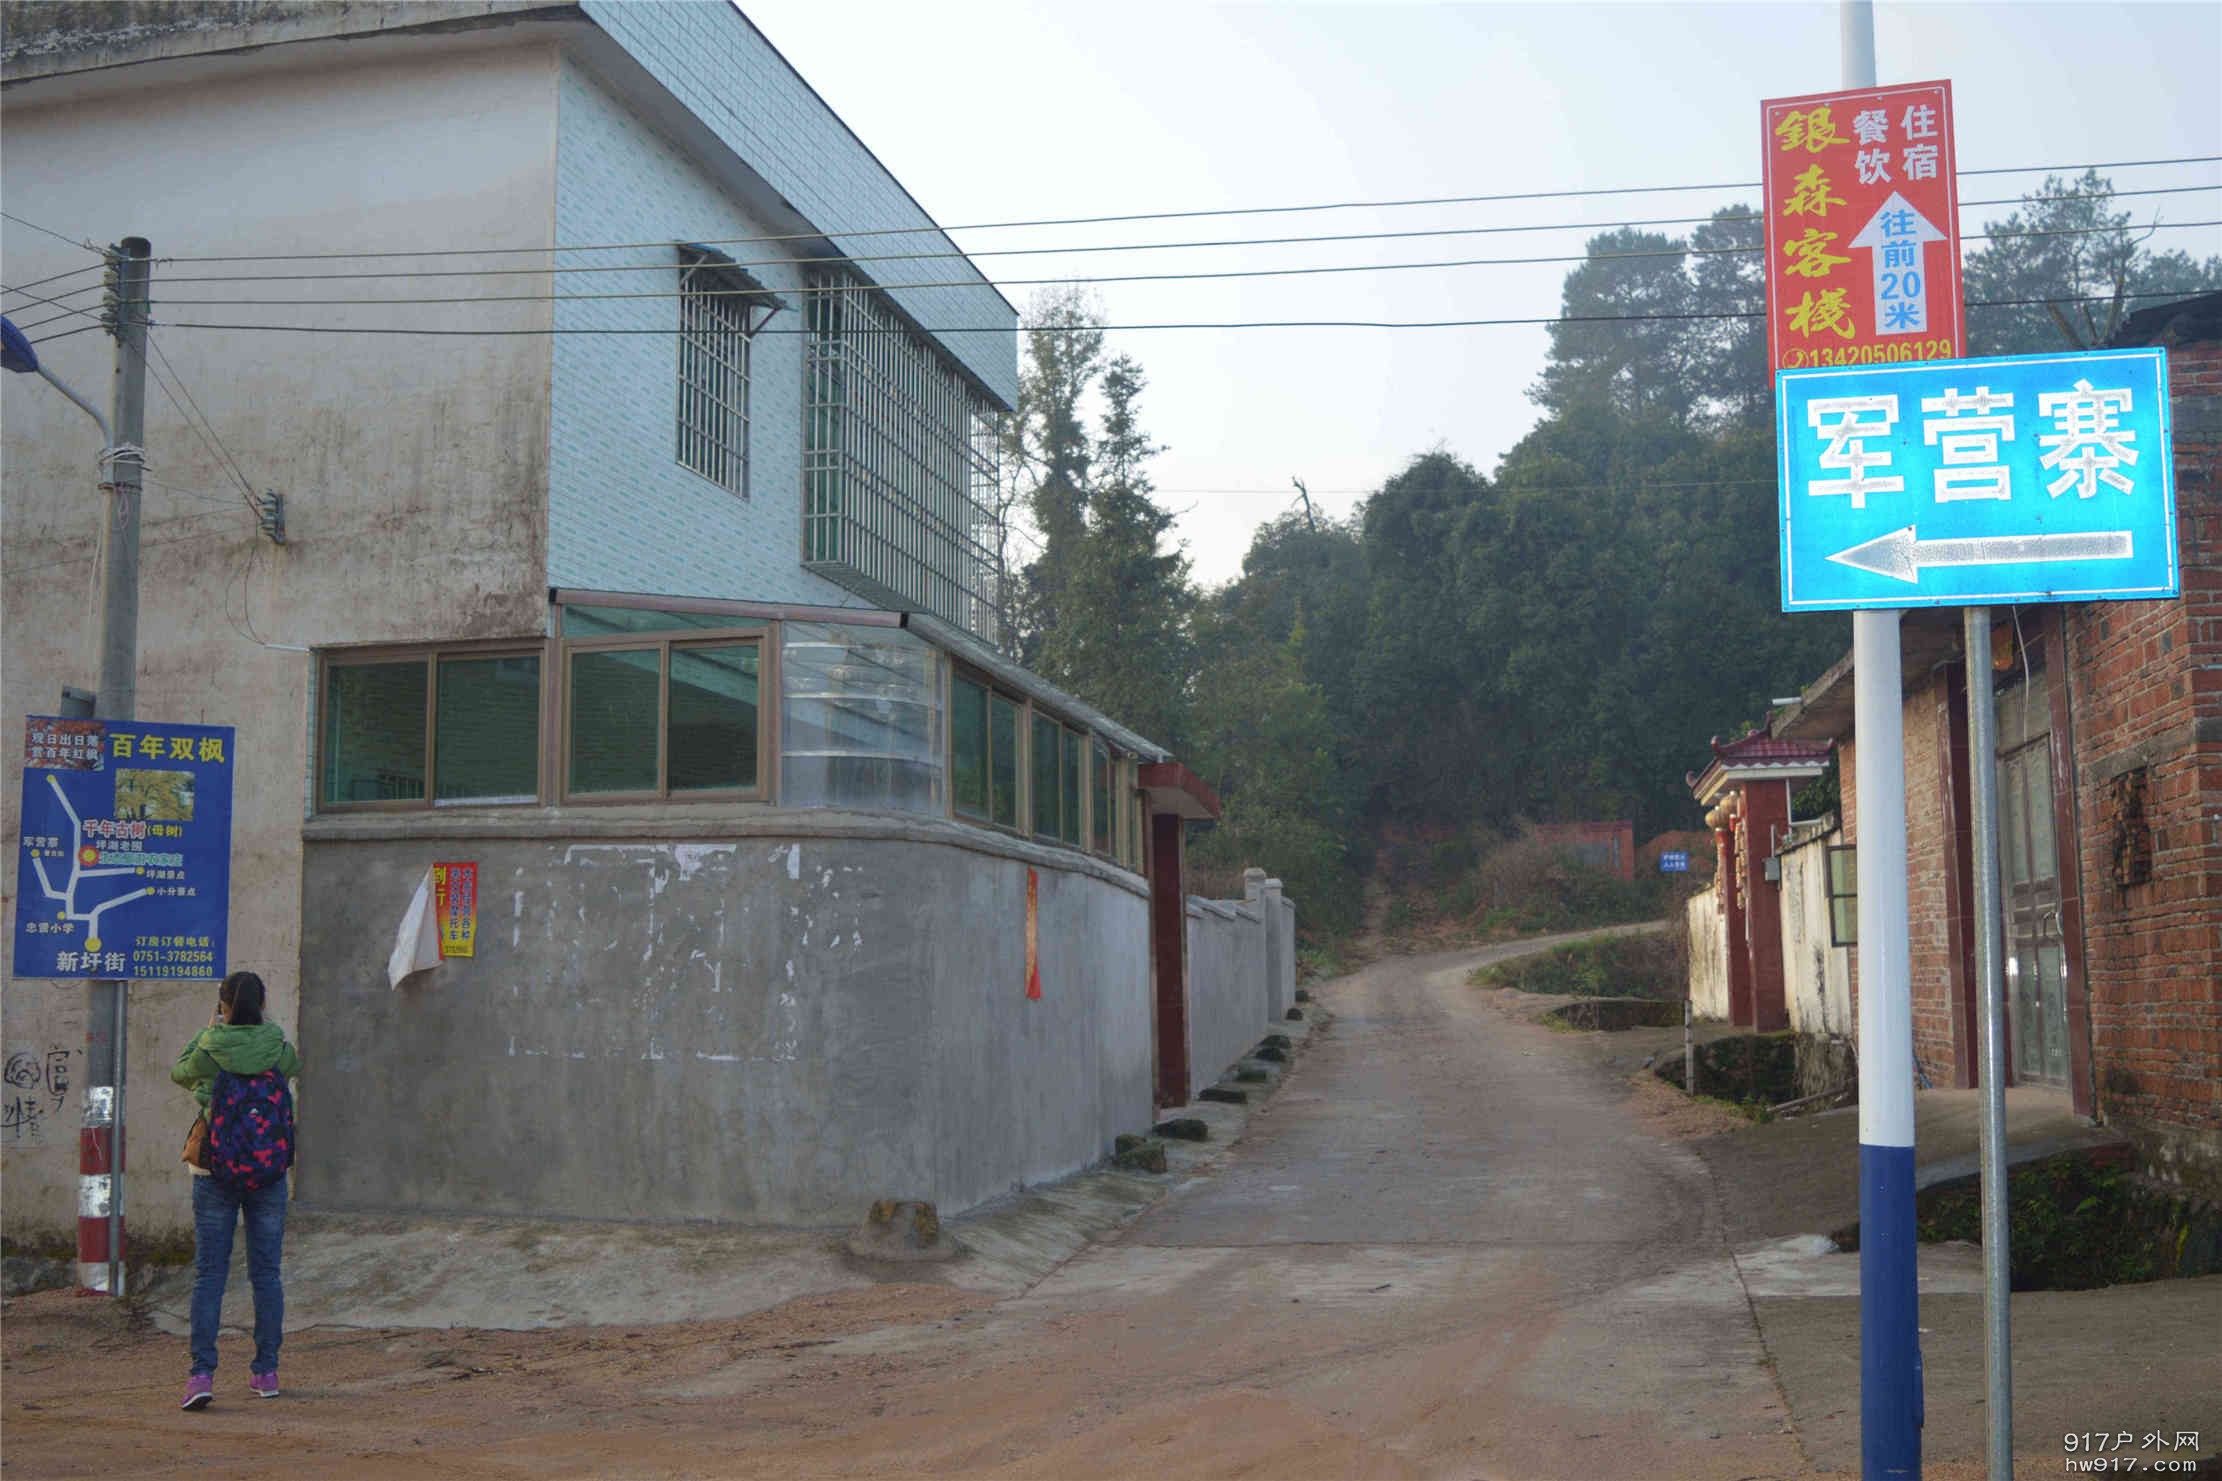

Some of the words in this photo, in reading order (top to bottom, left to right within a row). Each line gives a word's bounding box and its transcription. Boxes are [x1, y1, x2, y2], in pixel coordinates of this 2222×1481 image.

[1853, 109, 1892, 185] 餐饮
[1900, 105, 1938, 181] 住宿
[1810, 339, 1953, 368] 13420506129
[1807, 379, 2140, 509] 军营寨
[109, 733, 225, 764] 百年双枫
[56, 951, 126, 973] 新圩街
